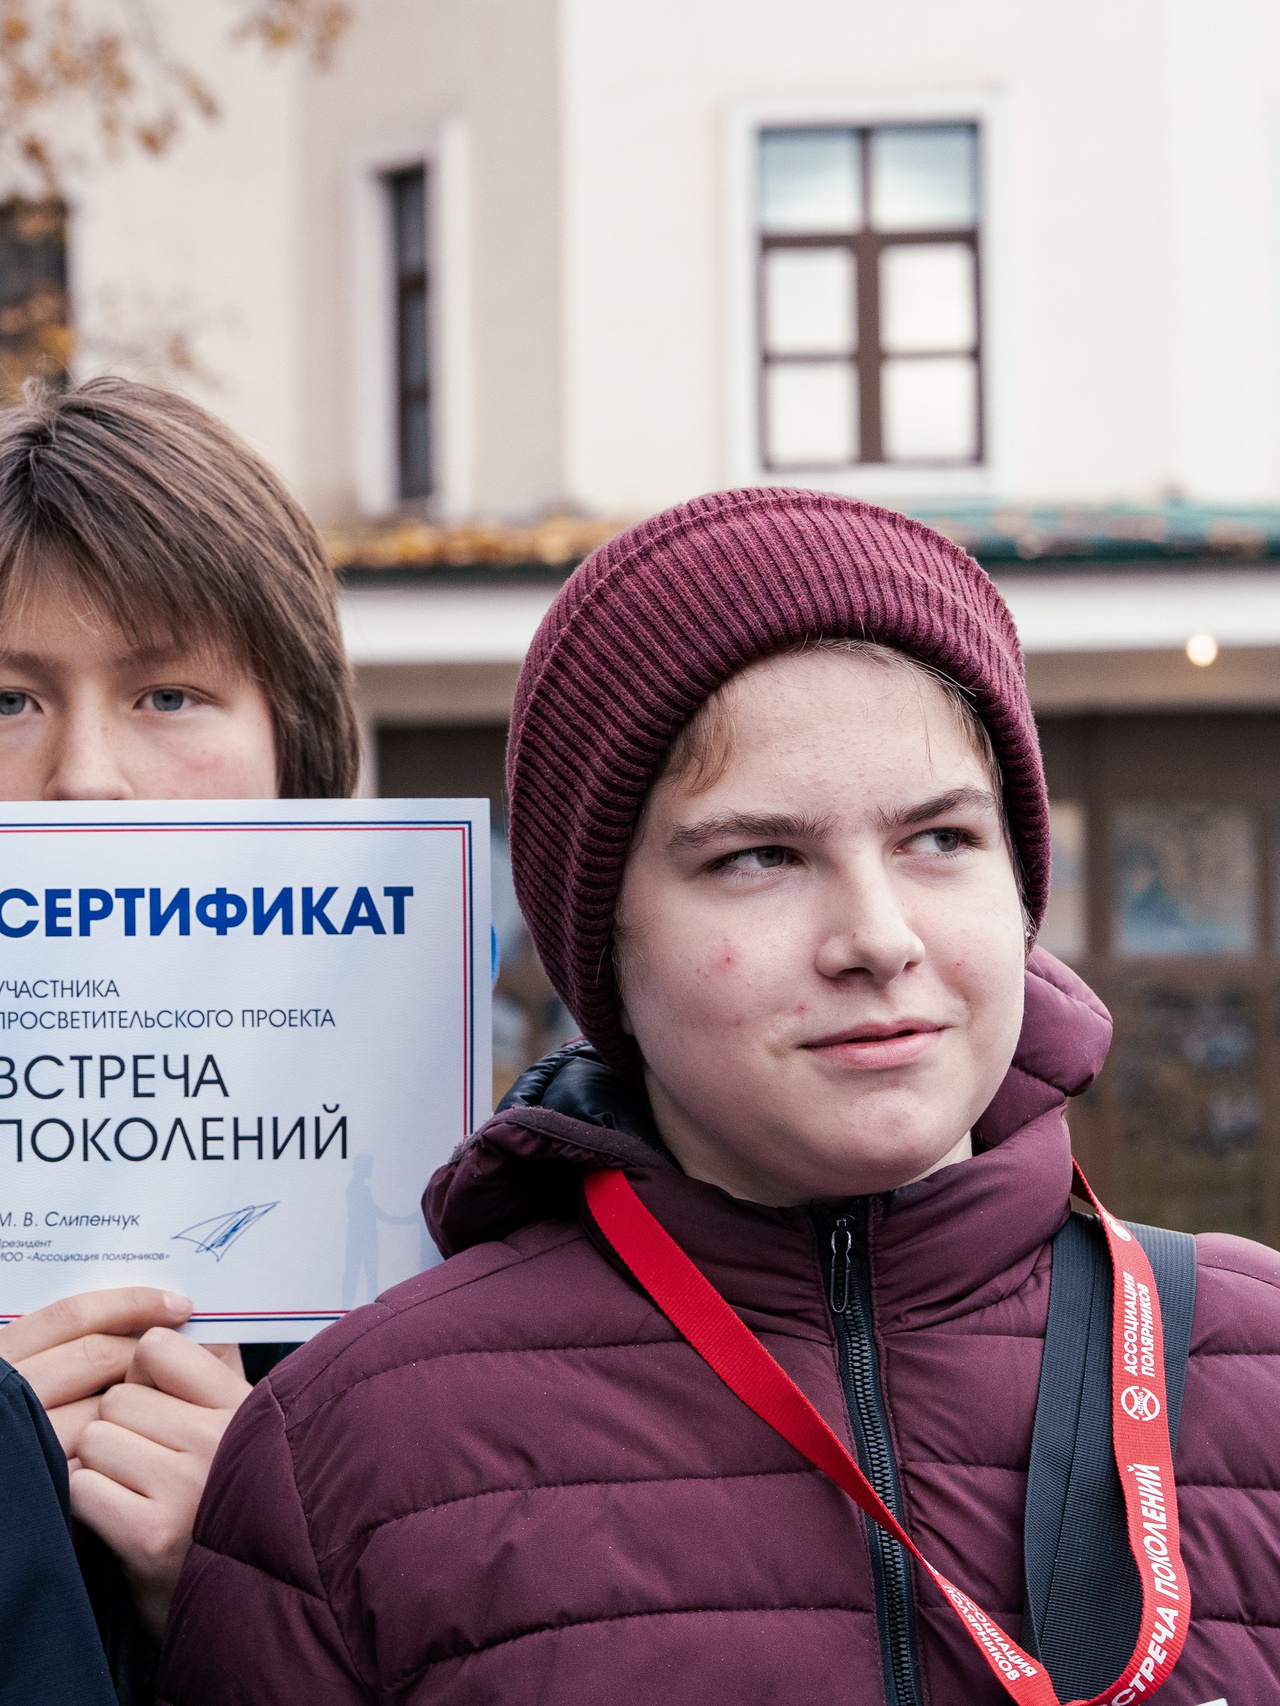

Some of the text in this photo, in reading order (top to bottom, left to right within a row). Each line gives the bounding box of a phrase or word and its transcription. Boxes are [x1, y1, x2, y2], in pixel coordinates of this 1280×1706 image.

[241, 1009, 336, 1028] ПРОЕКТА
[23, 1211, 39, 1227] В.
[44, 1211, 140, 1230] Слипенчук
[1122, 1270, 1140, 1377] АССОЦИАЦИЯ
[1137, 1282, 1156, 1378] ПОЛЯРНИКОВ
[1097, 1463, 1180, 1706] СТРЕЧА ПОКОЛЕНИЙ
